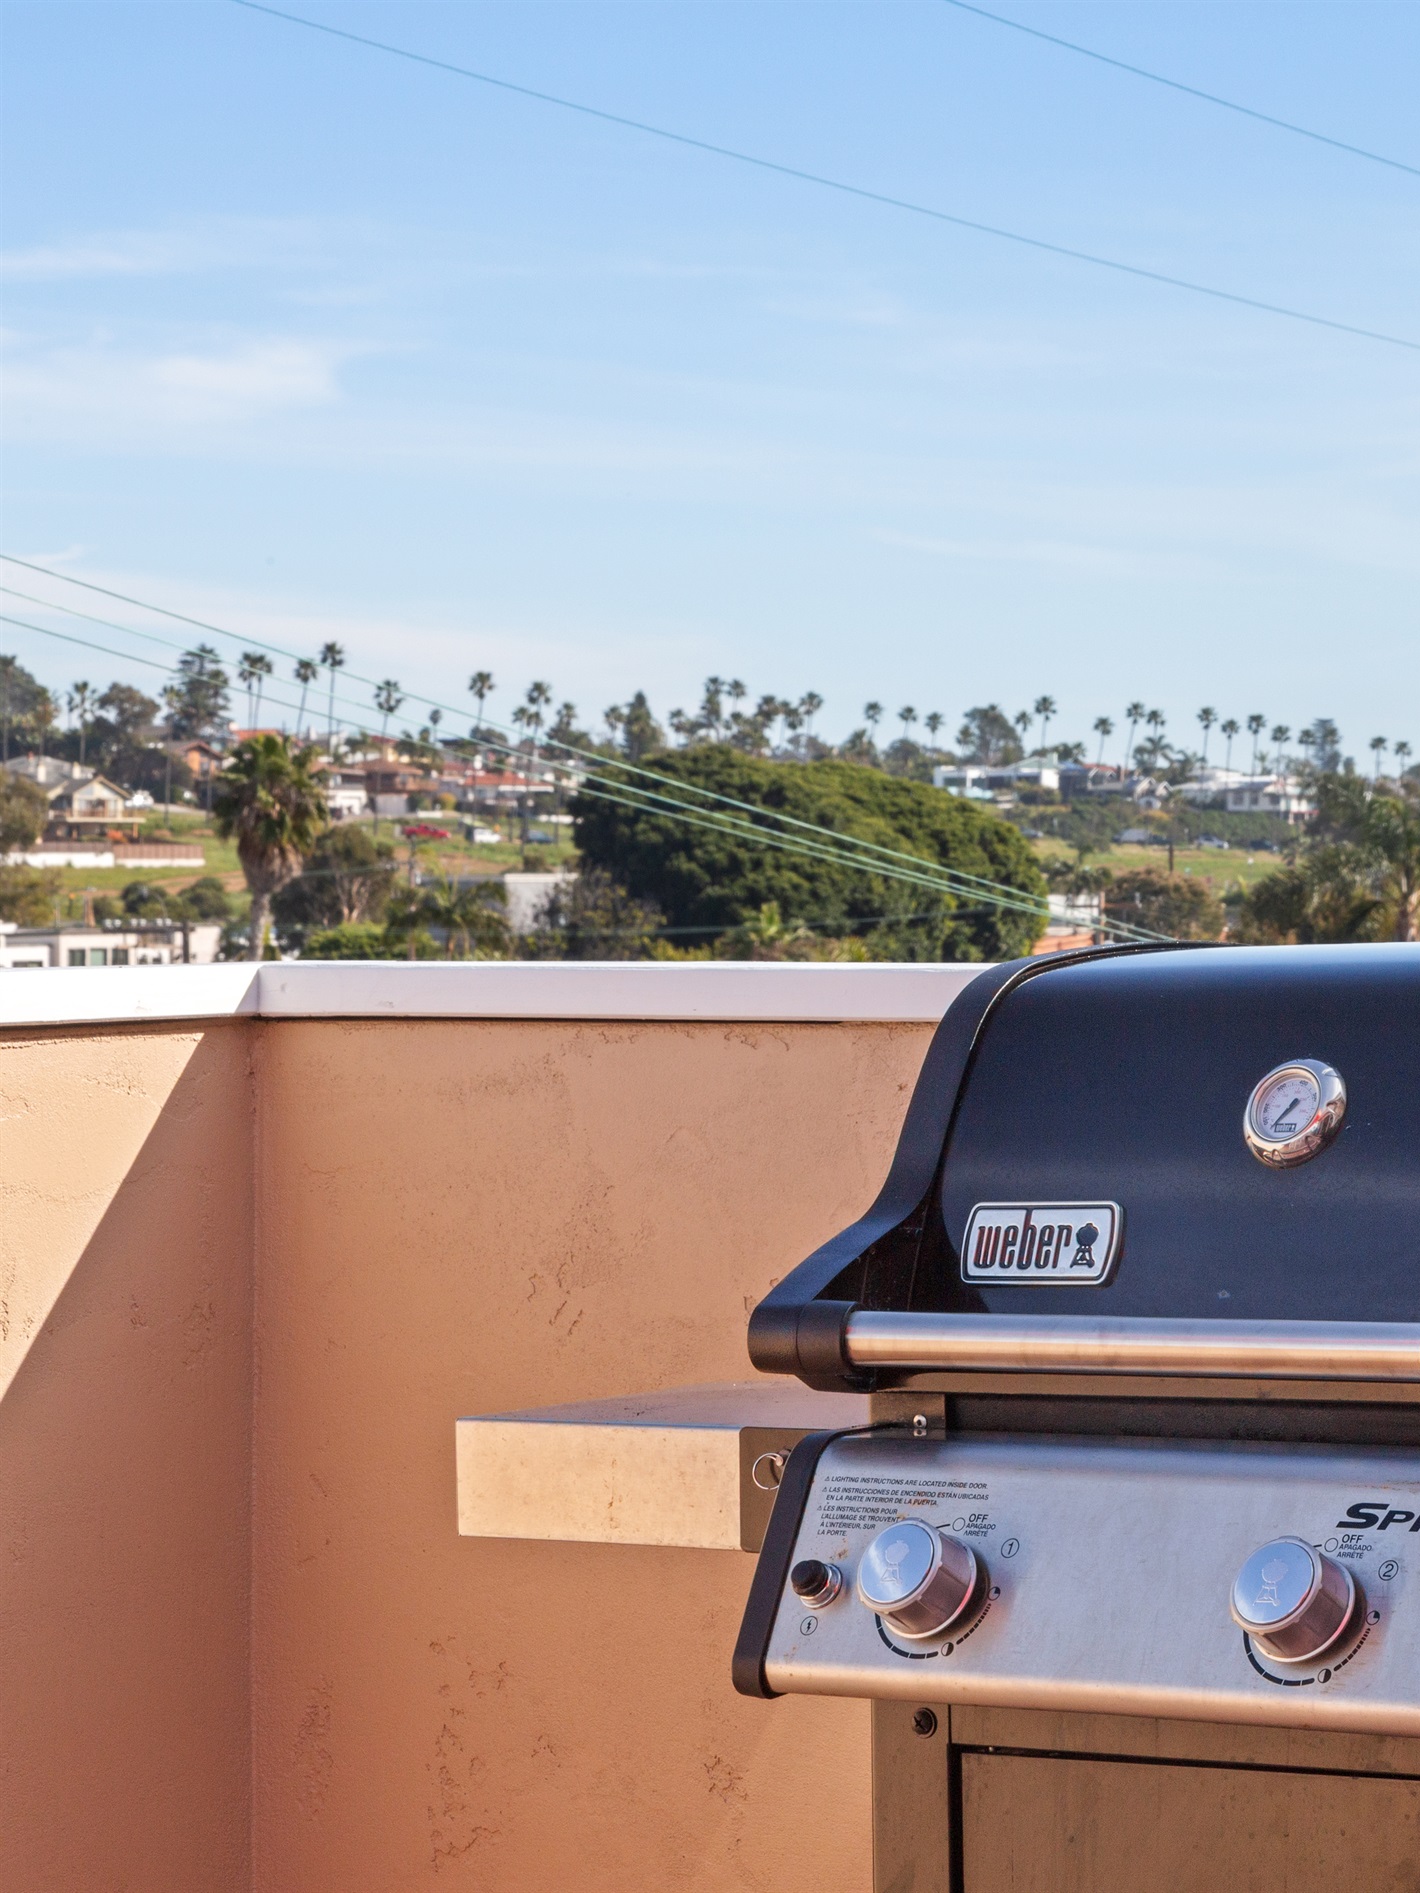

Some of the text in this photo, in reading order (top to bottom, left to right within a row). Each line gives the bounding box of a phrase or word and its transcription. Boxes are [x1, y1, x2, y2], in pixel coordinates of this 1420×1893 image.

[973, 1208, 1073, 1270] weber
[859, 1477, 904, 1486] INSTRUCTIONS
[841, 1487, 890, 1496] INSTRUCCIONES
[900, 1490, 936, 1498] ENCENDIDO
[937, 1491, 957, 1499] ESTÁN
[957, 1493, 989, 1501] UBICADAS
[835, 1506, 880, 1514] INSTRUCTIONS
[867, 1515, 900, 1523] TROUVENT
[968, 1513, 989, 1523] OFF
[965, 1522, 996, 1531] APAGADO
[1341, 1533, 1364, 1543] OFF
[1338, 1543, 1373, 1552] APAGADO
[1382, 1563, 1394, 1577] 2
